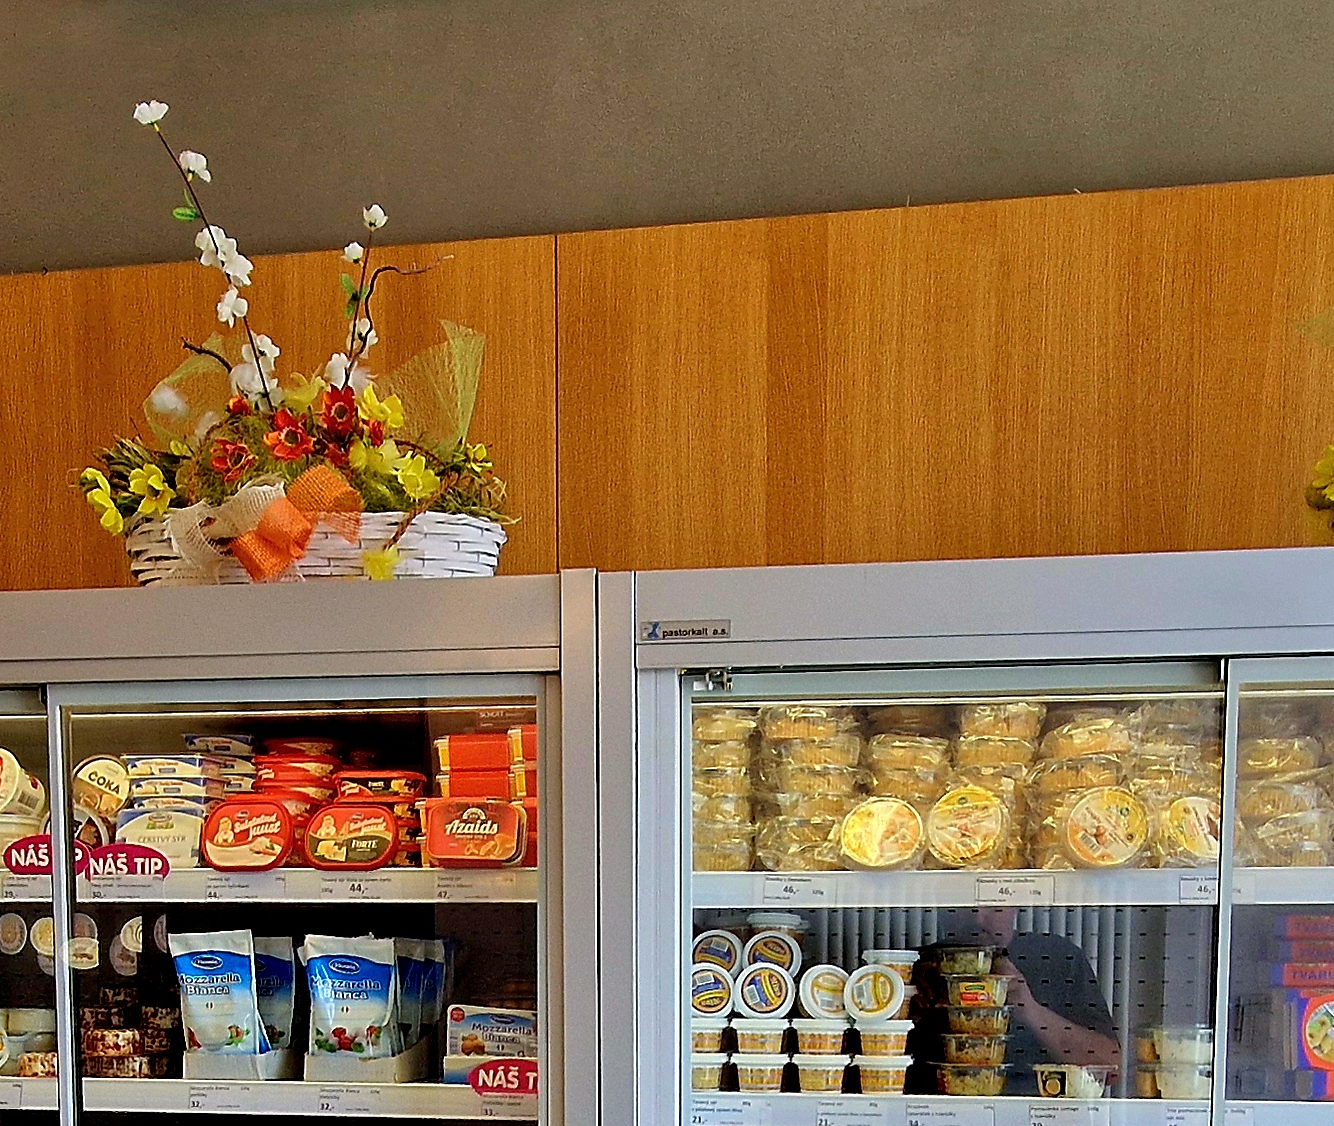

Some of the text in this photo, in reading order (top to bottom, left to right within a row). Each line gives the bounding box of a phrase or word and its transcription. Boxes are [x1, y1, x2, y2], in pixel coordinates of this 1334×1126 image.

[662, 628, 728, 639] pastorkalt a.s.
[88, 771, 120, 795] ČOKA
[445, 818, 499, 836] Azaids
[352, 839, 378, 850] FORTE
[11, 843, 50, 867] NÁŠ
[90, 852, 128, 875] NÁŠ
[134, 857, 164, 875] TIP
[350, 884, 368, 895] 44,-
[783, 885, 799, 895] 46,-
[998, 887, 1016, 896] 46,-
[1197, 885, 1215, 894] 46,-
[186, 984, 230, 996] Bianca
[471, 1022, 533, 1037] Mozzarella
[478, 1065, 519, 1089] NÁŠ
[692, 1116, 708, 1125] 21,-
